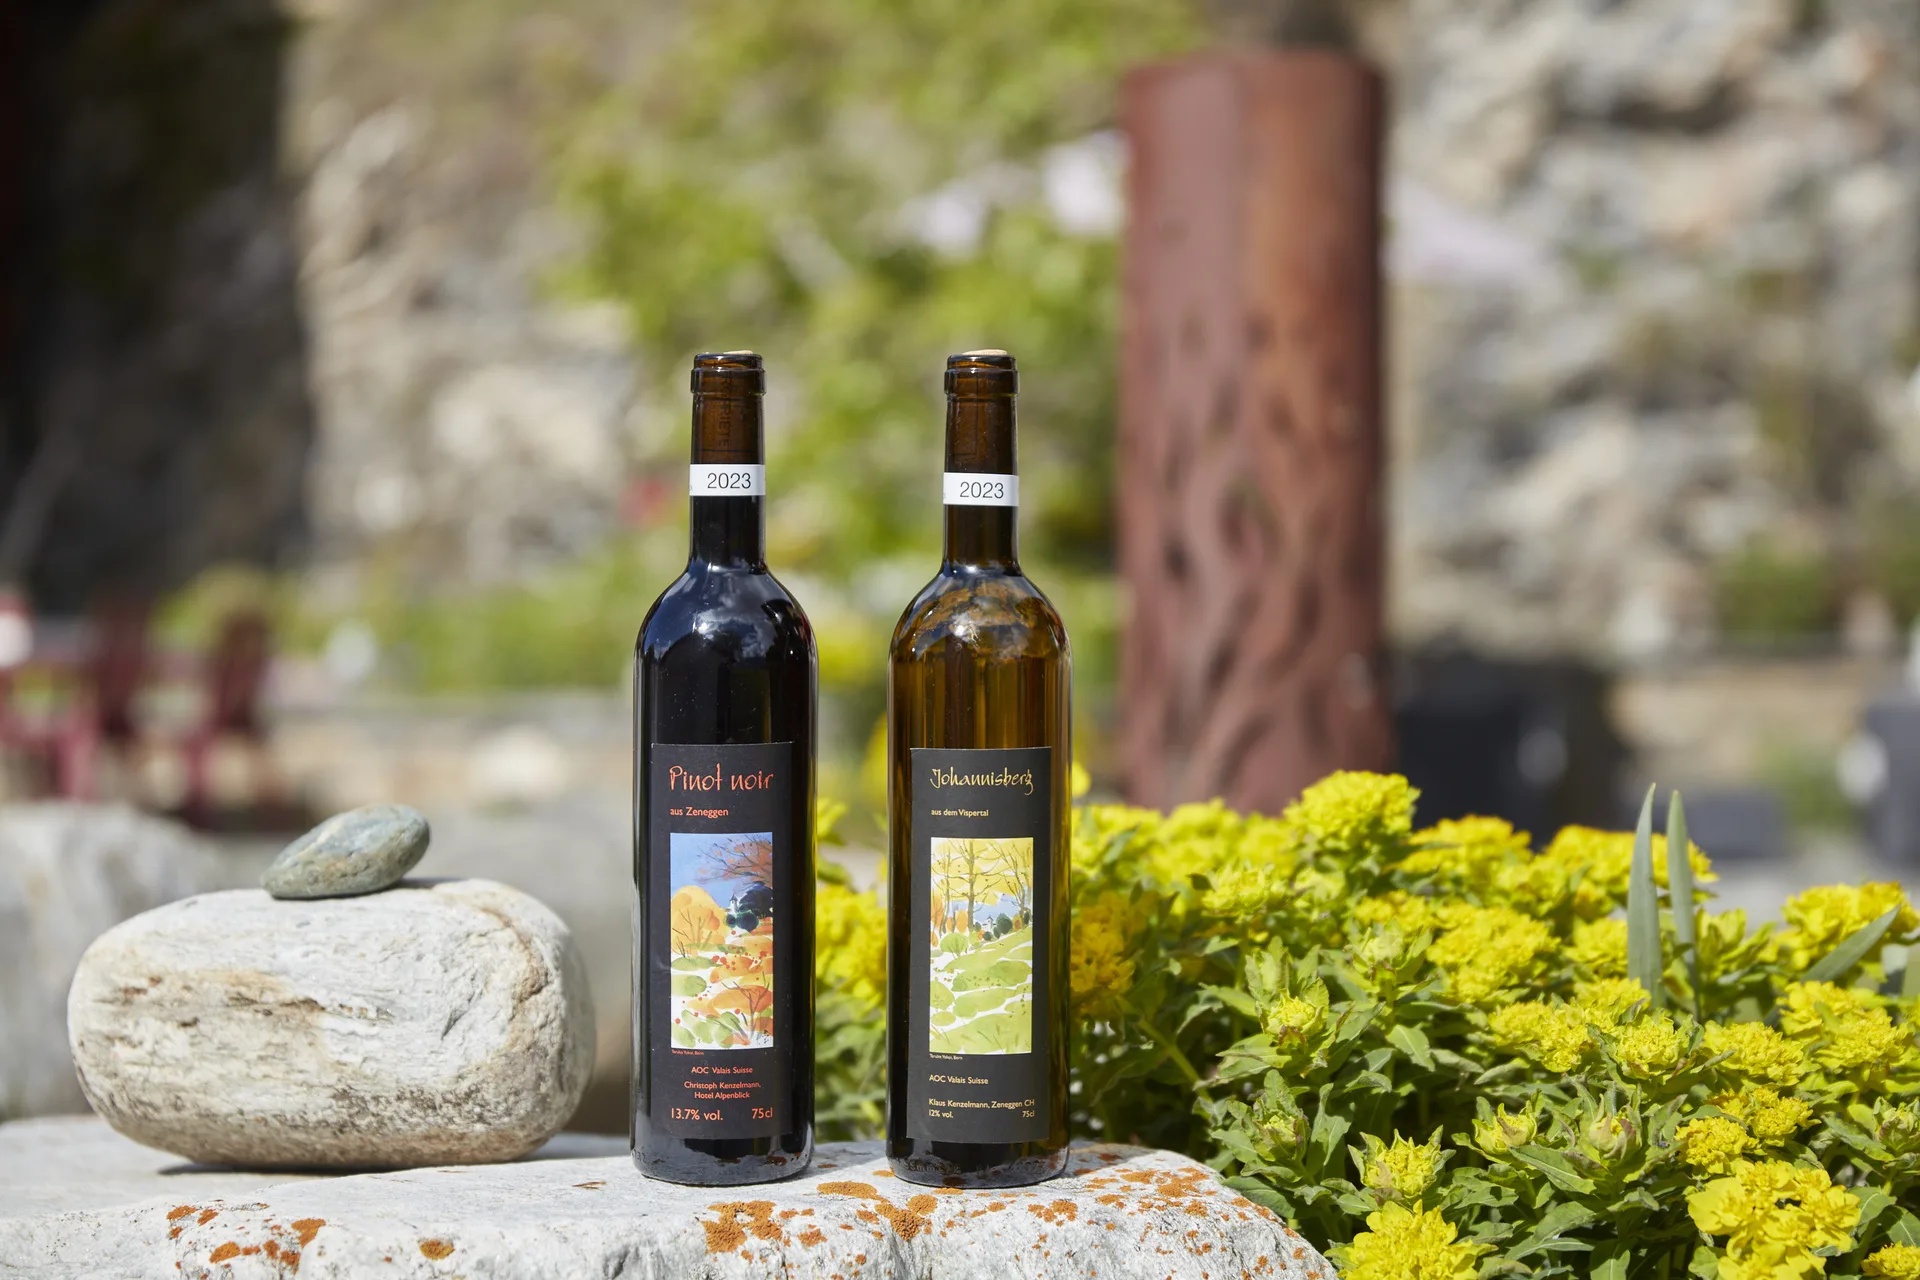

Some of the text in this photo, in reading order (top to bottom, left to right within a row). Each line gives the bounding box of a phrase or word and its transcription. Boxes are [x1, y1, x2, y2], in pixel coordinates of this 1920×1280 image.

[707, 472, 751, 489] 2023
[960, 481, 1004, 499] 2023
[669, 763, 773, 791] Pinot noir
[930, 766, 1033, 795] Johannisberg
[686, 807, 728, 819] Zeneggen
[958, 809, 989, 818] Vispertal
[691, 1066, 709, 1074] AOC
[733, 1066, 753, 1074] Suisse
[929, 1074, 988, 1084] AOC Valais Suisse
[684, 1081, 717, 1091] Christoph
[715, 1092, 750, 1100] Alpenblick
[929, 1098, 946, 1107] Klaus
[991, 1101, 1022, 1109] Zeneggen
[1024, 1099, 1035, 1107] CH
[671, 1107, 773, 1120] 13.7% vol. 75cl
[929, 1109, 940, 1117] 12%
[1022, 1110, 1034, 1118] 75cl
